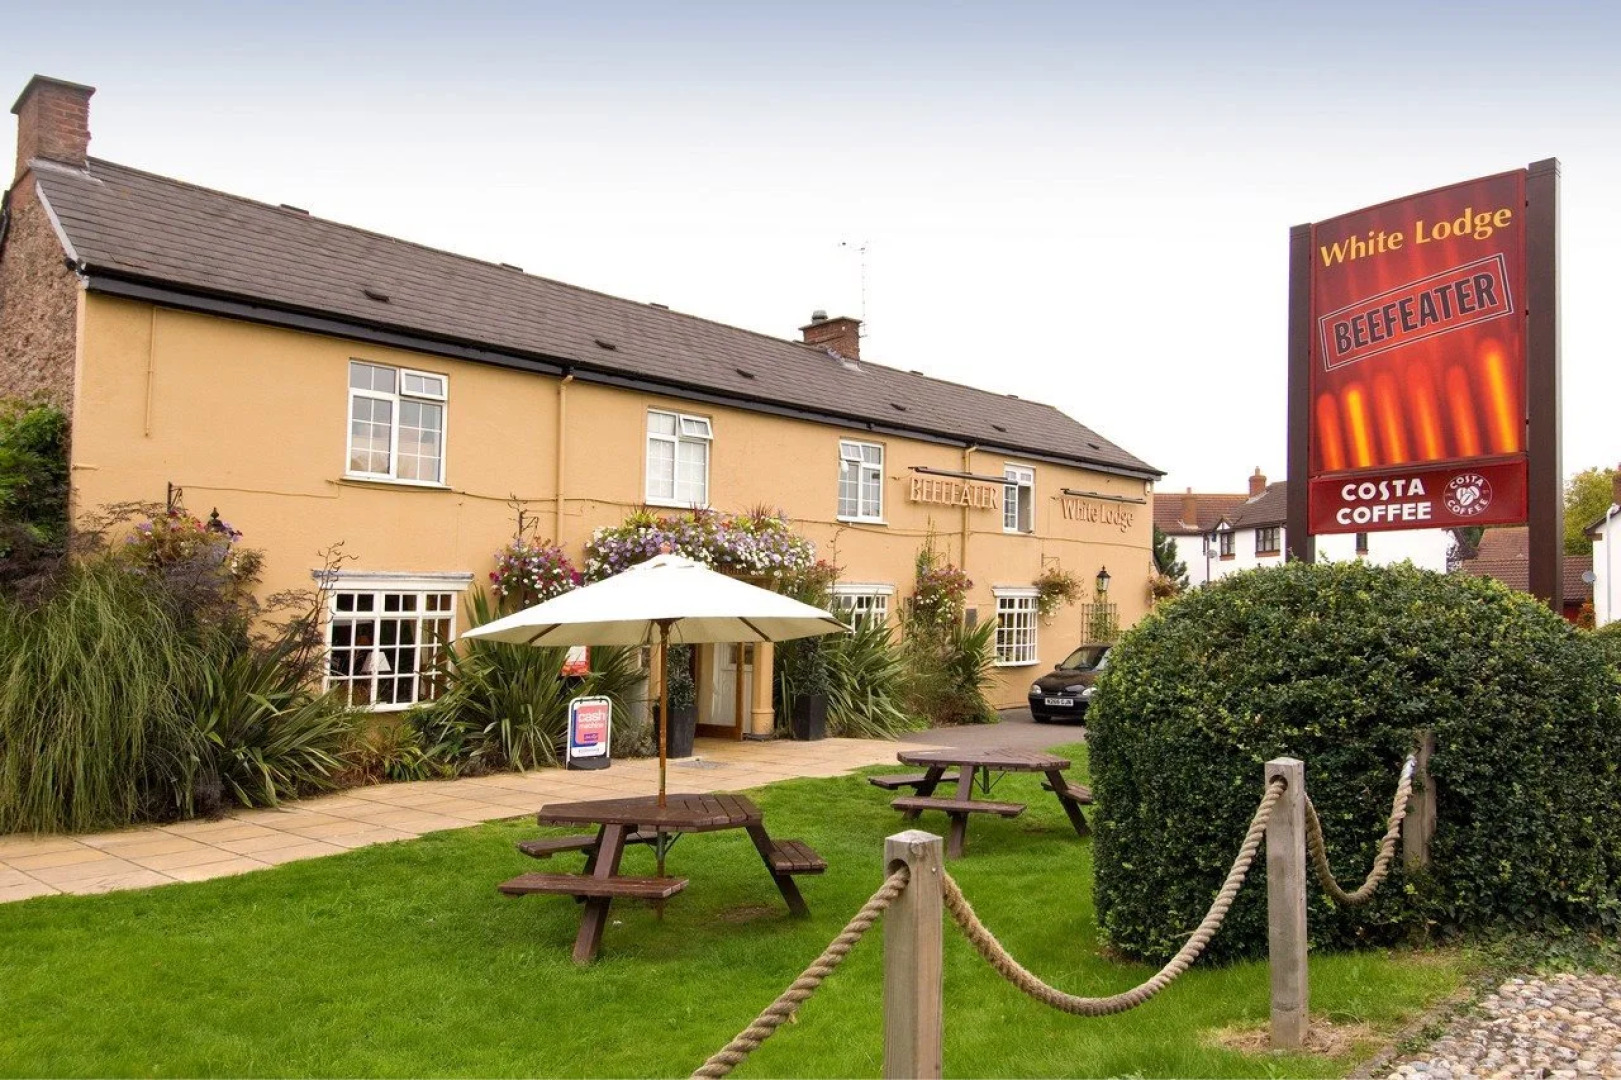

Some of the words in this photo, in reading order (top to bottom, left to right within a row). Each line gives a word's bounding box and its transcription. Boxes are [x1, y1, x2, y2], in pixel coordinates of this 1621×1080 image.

[1320, 231, 1403, 267] White
[1415, 207, 1512, 244] Lodge
[1334, 272, 1498, 355] BEEFEATER
[909, 477, 998, 510] BEEFEATER
[1341, 478, 1426, 502] COSTA
[1449, 475, 1484, 490] COSTA
[1062, 498, 1098, 523] White
[1100, 504, 1134, 533] Lodge
[1335, 502, 1431, 525] COFFEE
[1447, 498, 1489, 515] COFFEE
[578, 710, 606, 721] cash
